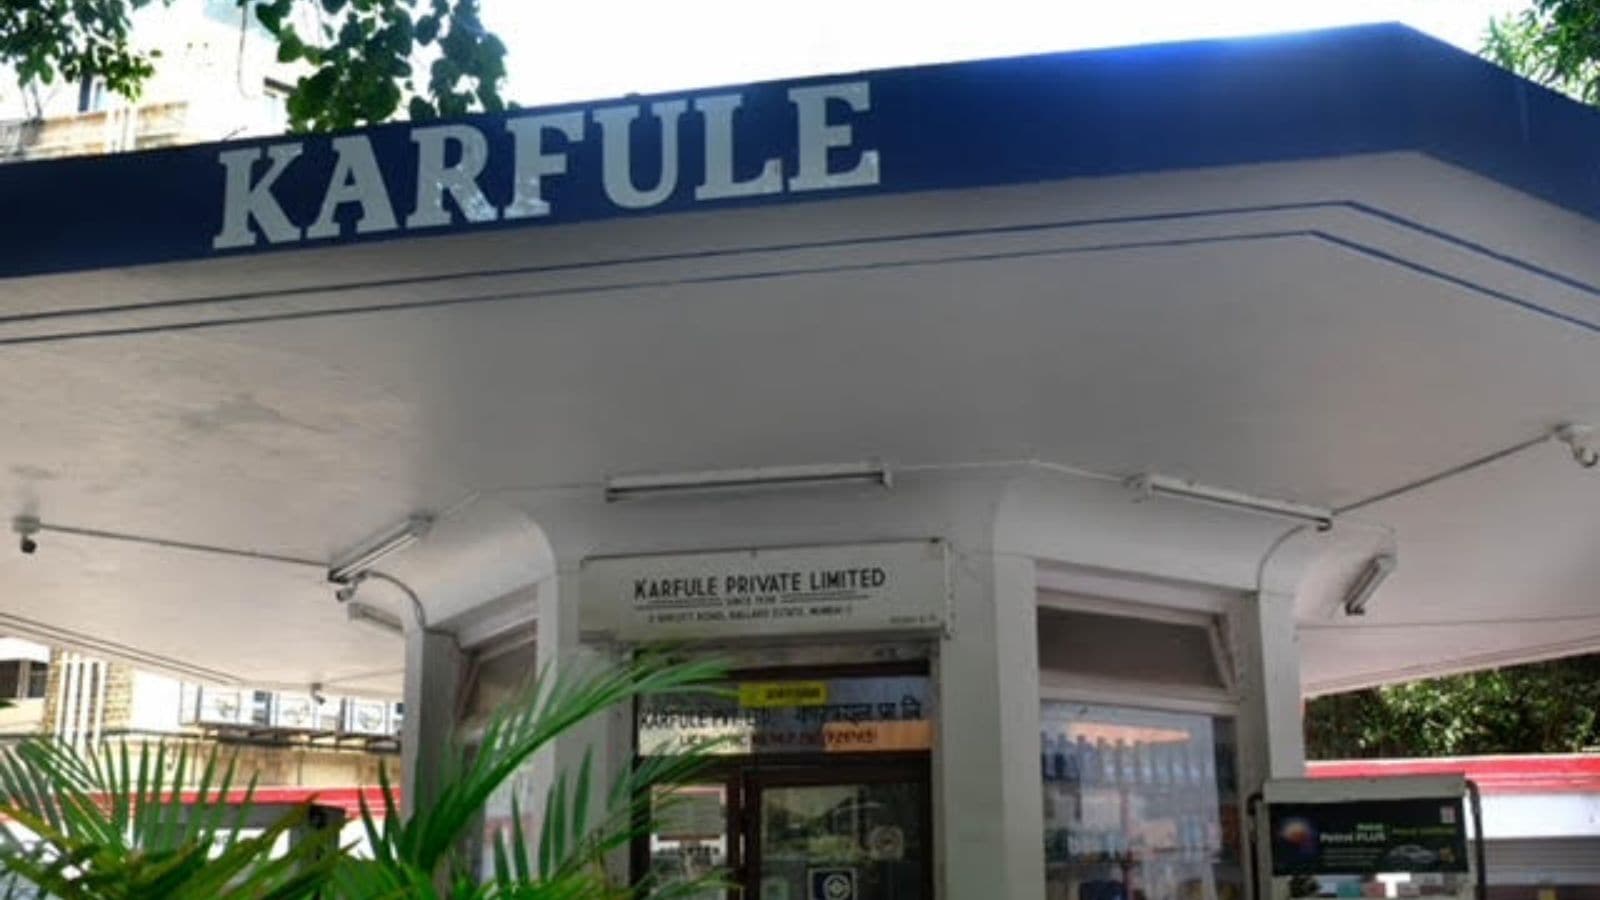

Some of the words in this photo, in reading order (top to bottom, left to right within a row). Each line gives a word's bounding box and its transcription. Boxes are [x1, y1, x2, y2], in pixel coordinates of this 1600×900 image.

[212, 80, 880, 250] KARFULE
[634, 577, 718, 600] KARFULE
[725, 572, 802, 595] PRIVATE
[810, 567, 886, 591] LIMITED
